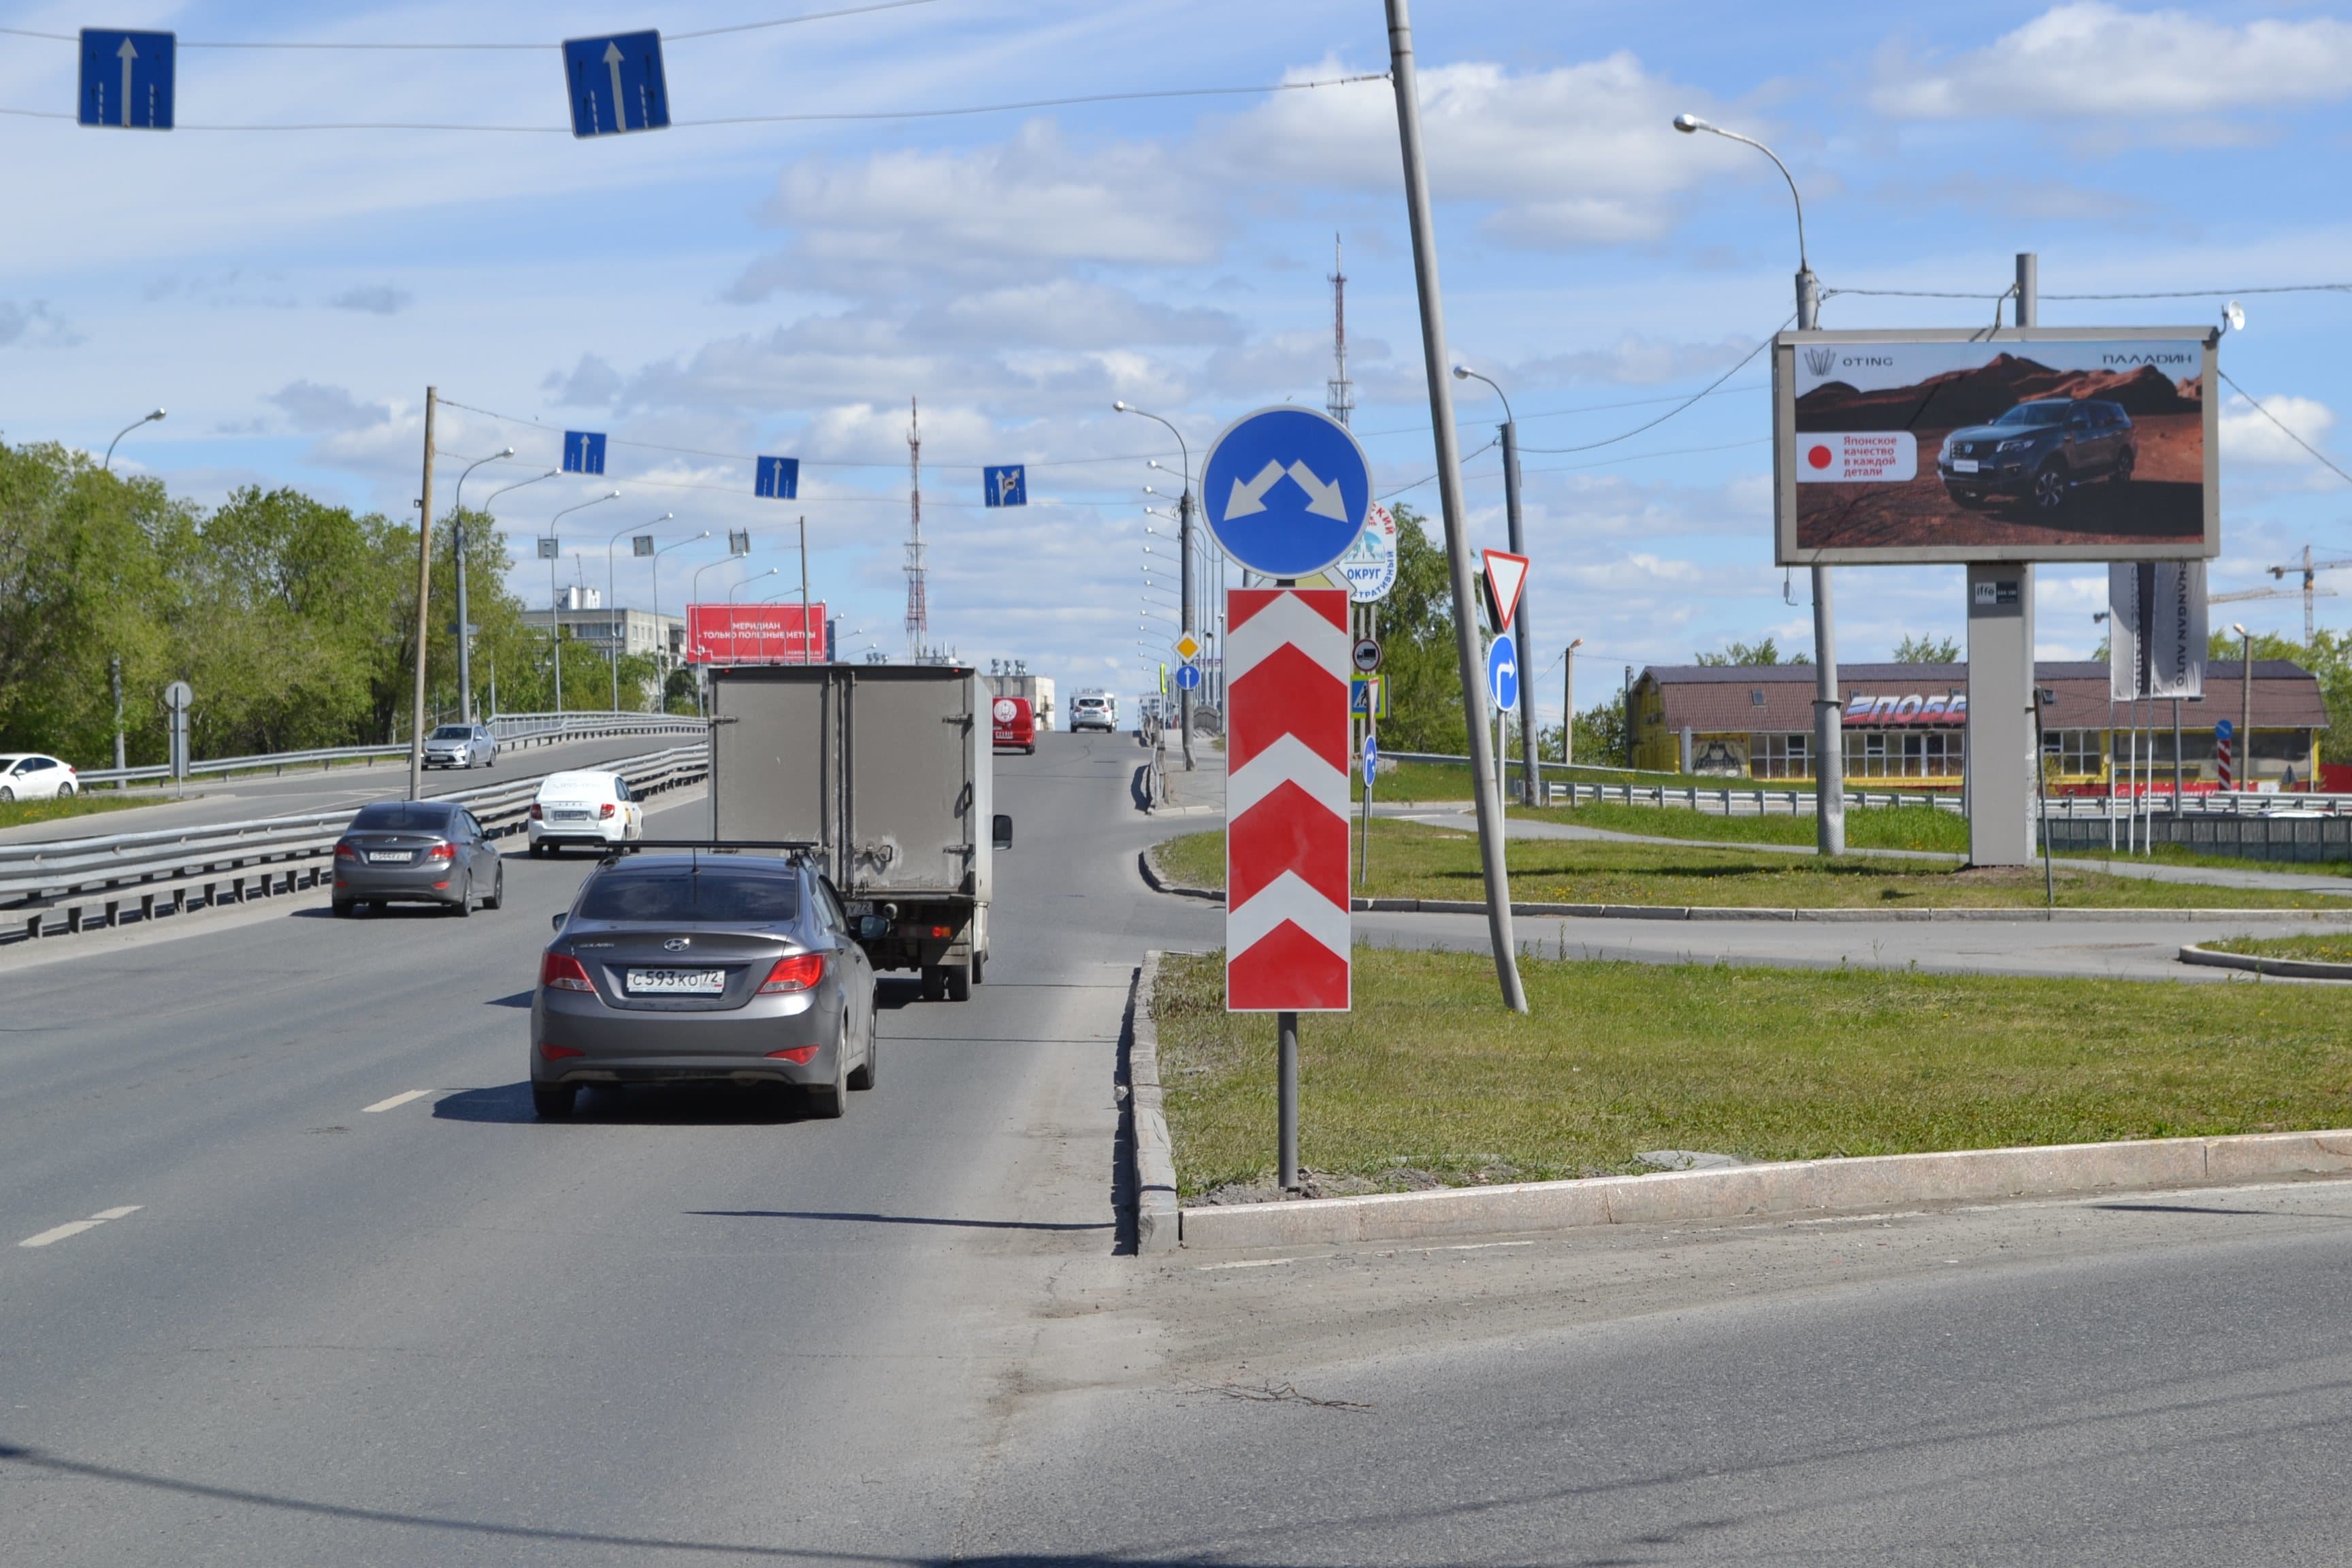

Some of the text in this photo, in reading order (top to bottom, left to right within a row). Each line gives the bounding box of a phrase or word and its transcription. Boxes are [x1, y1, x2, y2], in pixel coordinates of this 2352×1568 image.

[1842, 357, 1893, 367] OTING
[1843, 436, 1897, 446] Японское
[1844, 447, 1894, 456] качество
[1853, 457, 1896, 467] каждой
[1844, 468, 1882, 478] детали
[1347, 568, 1382, 580] ОКРУГ
[1354, 550, 1394, 599] ТРАТИВНЫЙ
[732, 622, 781, 630] МЕРИДИАН
[2176, 644, 2187, 687] AUTO
[859, 902, 869, 911] 72
[702, 970, 719, 983] 72
